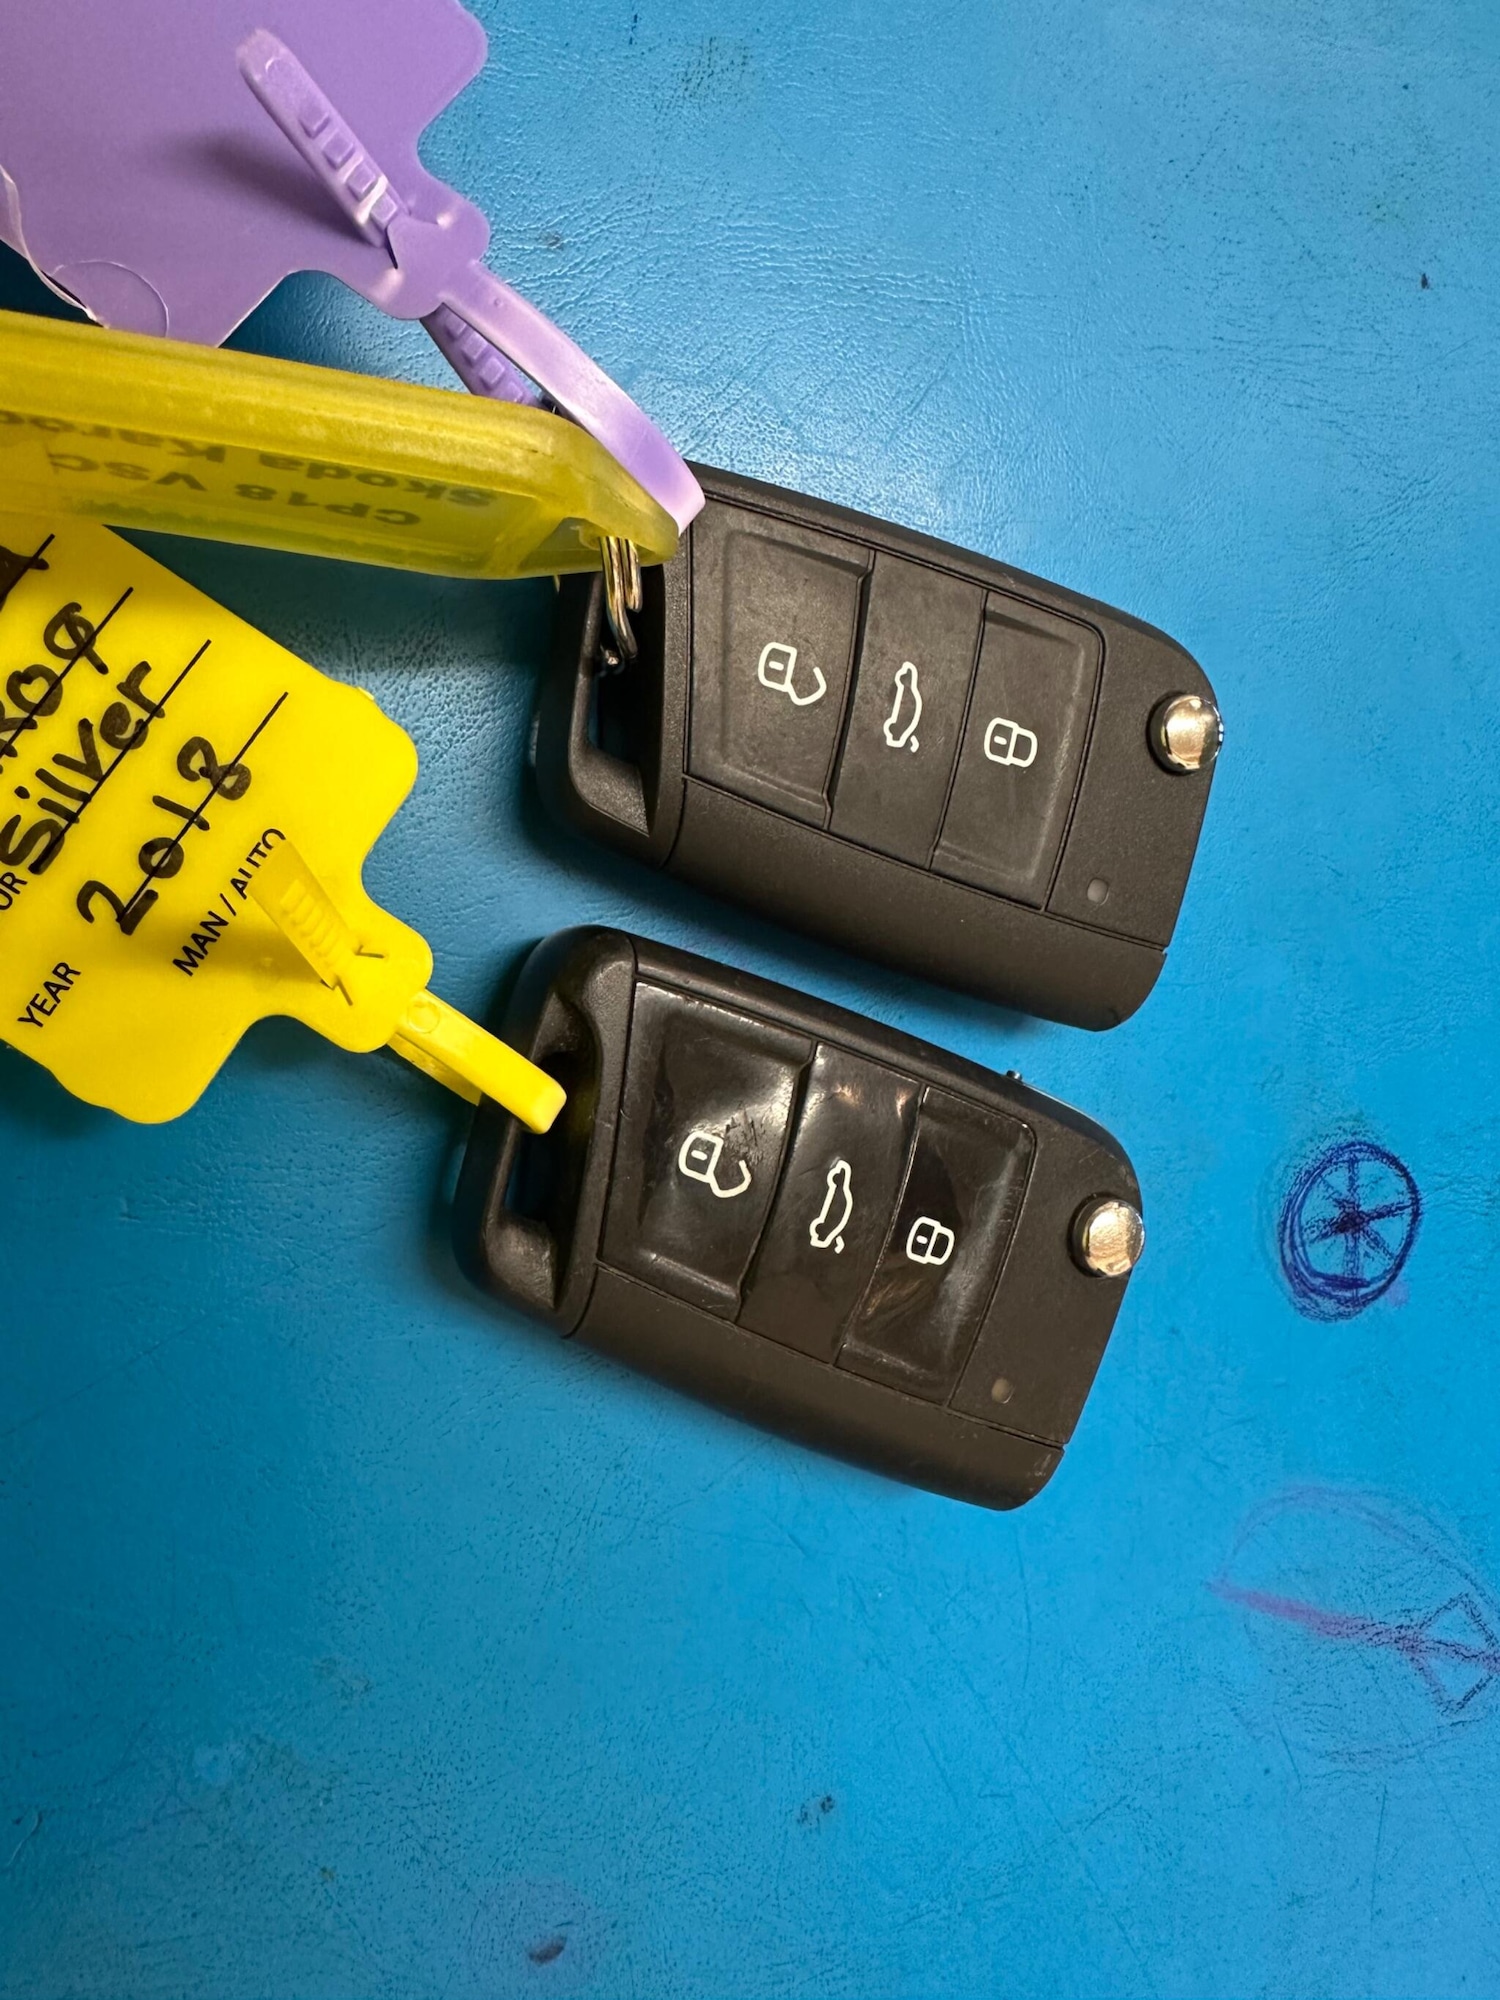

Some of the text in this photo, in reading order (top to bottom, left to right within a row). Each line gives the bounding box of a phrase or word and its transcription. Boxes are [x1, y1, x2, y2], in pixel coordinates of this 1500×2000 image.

[234, 483, 421, 526] CP18
[257, 453, 496, 507] Skoda
[76, 736, 252, 935] 2018
[172, 910, 229, 977] MAN
[18, 961, 81, 1028] YEAR
